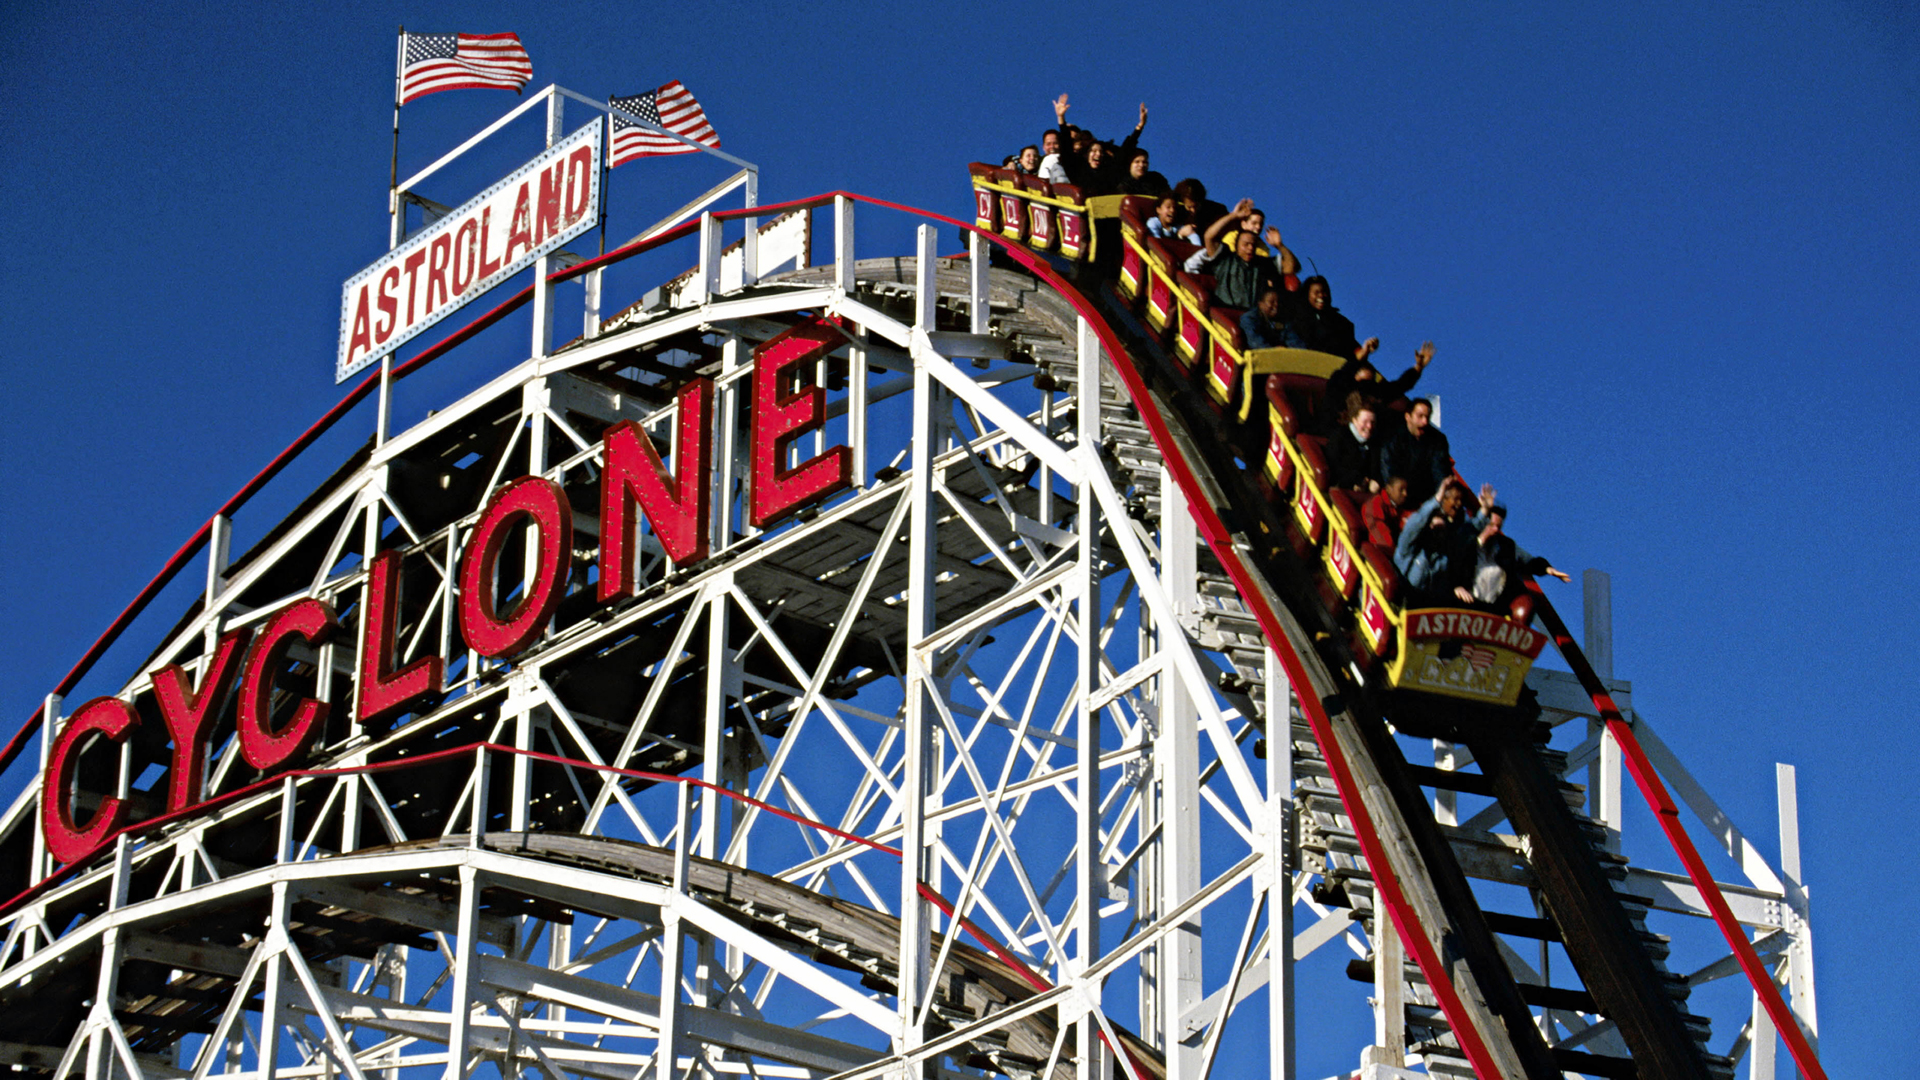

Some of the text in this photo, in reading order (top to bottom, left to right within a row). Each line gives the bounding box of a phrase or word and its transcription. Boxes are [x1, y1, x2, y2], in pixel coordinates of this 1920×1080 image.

[346, 145, 592, 366] ASTROLAND
[42, 308, 856, 866] CYCLONE
[1416, 613, 1534, 651] ASTROLAND
